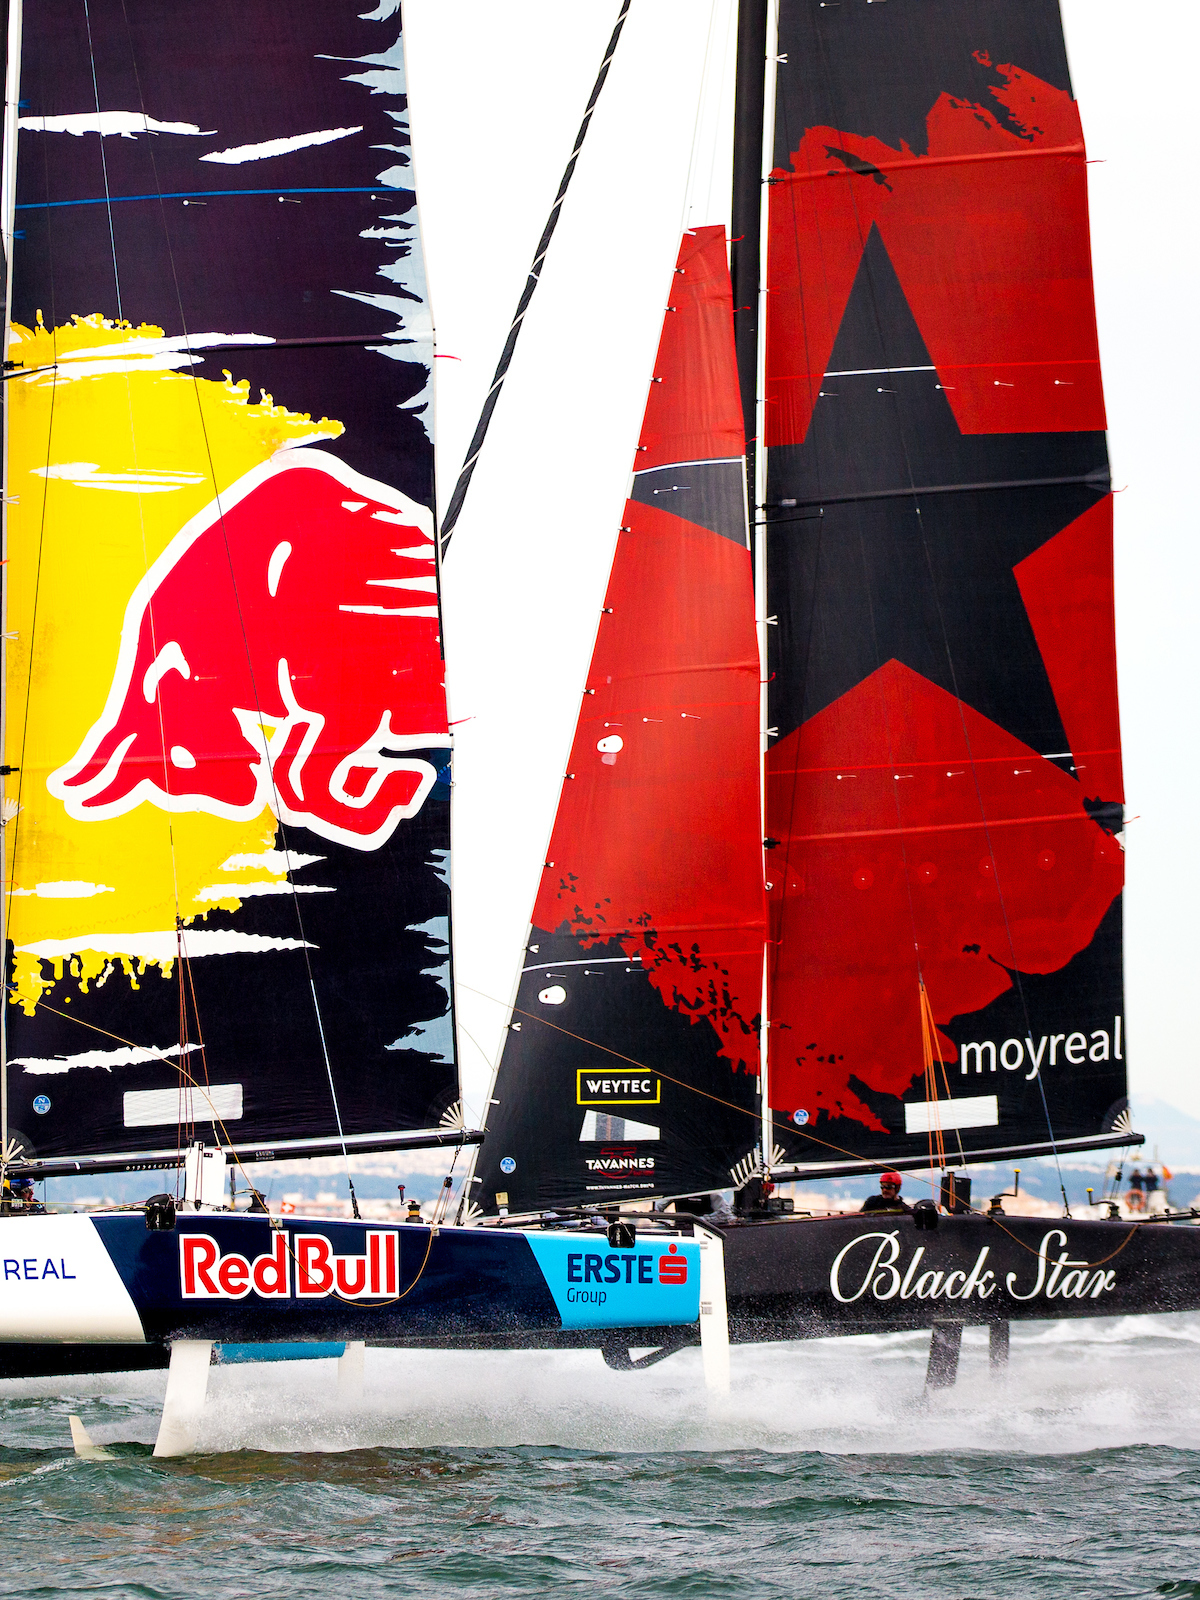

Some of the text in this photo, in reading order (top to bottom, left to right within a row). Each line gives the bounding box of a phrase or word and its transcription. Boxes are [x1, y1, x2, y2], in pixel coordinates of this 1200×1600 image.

[961, 1015, 1123, 1081] moyreal
[586, 1080, 651, 1094] WEYTEC
[585, 1158, 655, 1170] TAVANNES
[181, 1232, 398, 1297] Red Bull
[567, 1254, 653, 1283] ERSTE
[830, 1229, 1116, 1303] Black Star
[567, 1287, 607, 1306] Group
